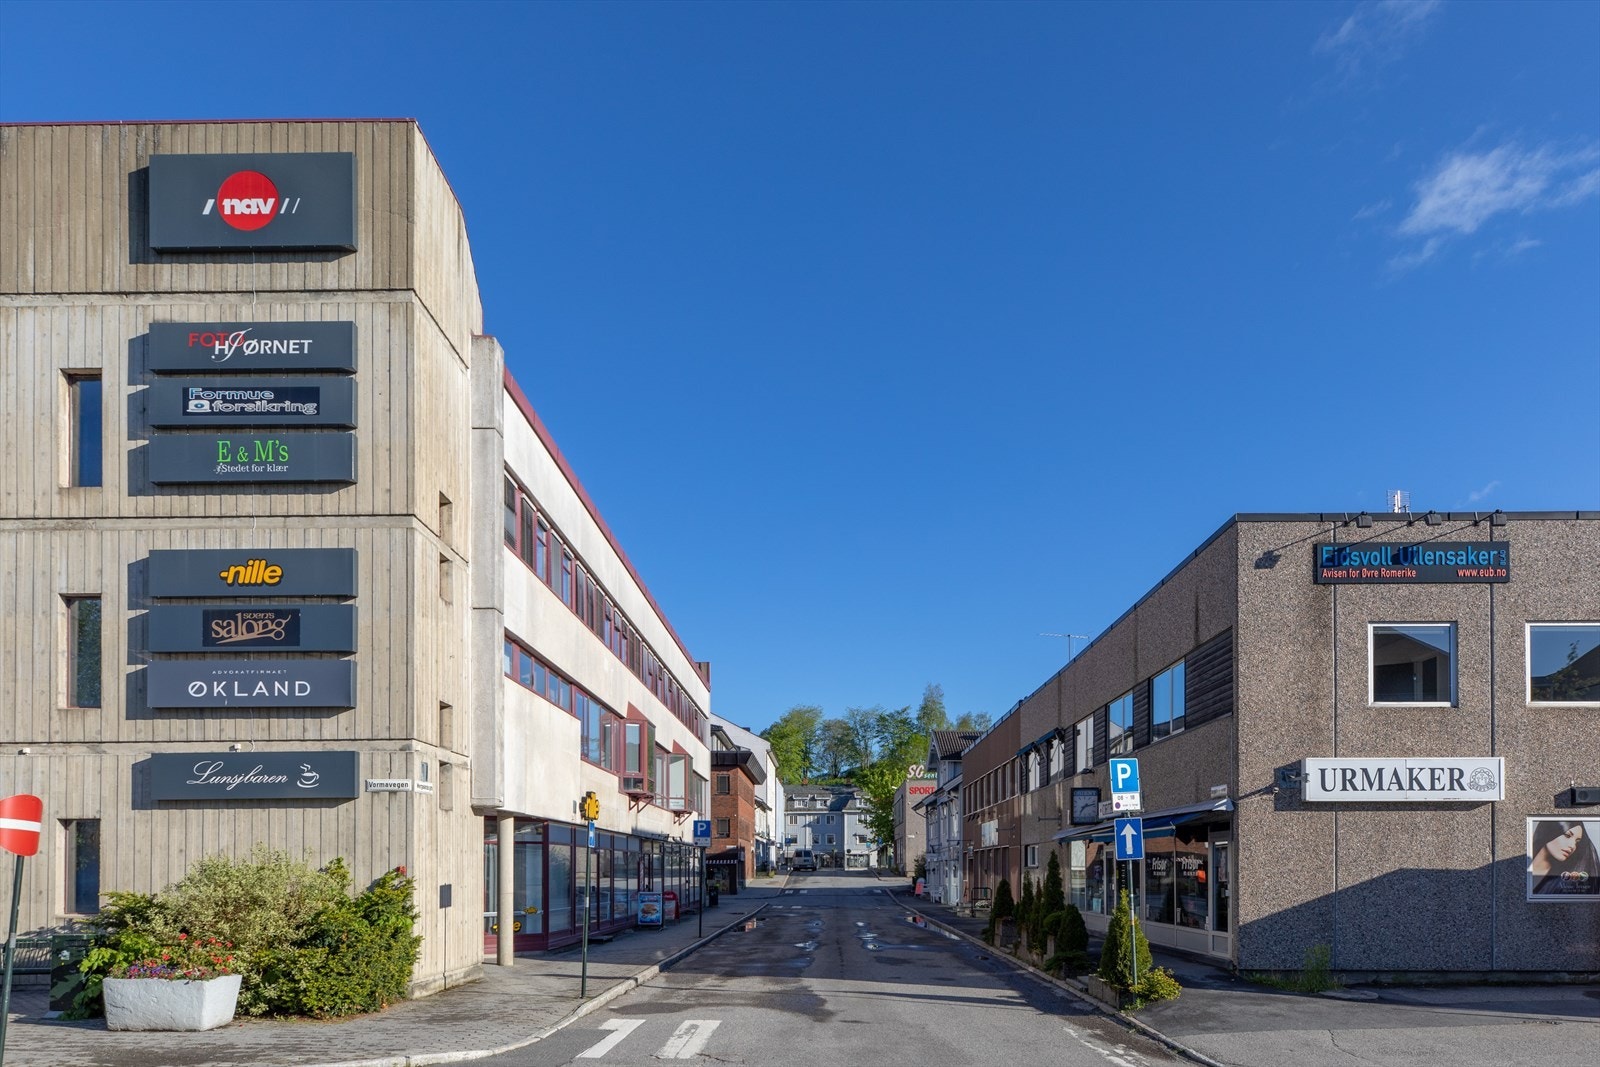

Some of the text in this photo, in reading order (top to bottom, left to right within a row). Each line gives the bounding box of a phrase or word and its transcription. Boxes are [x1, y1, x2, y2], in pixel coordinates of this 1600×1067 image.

[189, 388, 274, 400] Formue
[212, 400, 318, 415] forsikring
[217, 440, 232, 463] E
[237, 446, 249, 463] &
[222, 464, 289, 473] Stedet for klær
[1322, 546, 1393, 567] Eidsvoll
[1399, 545, 1499, 566] Ullensaker
[1322, 567, 1507, 578] Avisen for Øvre Romerike www.eub.no
[211, 612, 292, 641] salong
[188, 681, 311, 697] ØKLAND
[186, 760, 288, 790] Lunsjbaren
[1117, 764, 1131, 789] P
[1319, 767, 1467, 793] URMAKER
[368, 781, 409, 789] Vormavegen
[909, 786, 935, 795] SPORT
[697, 822, 707, 836] P
